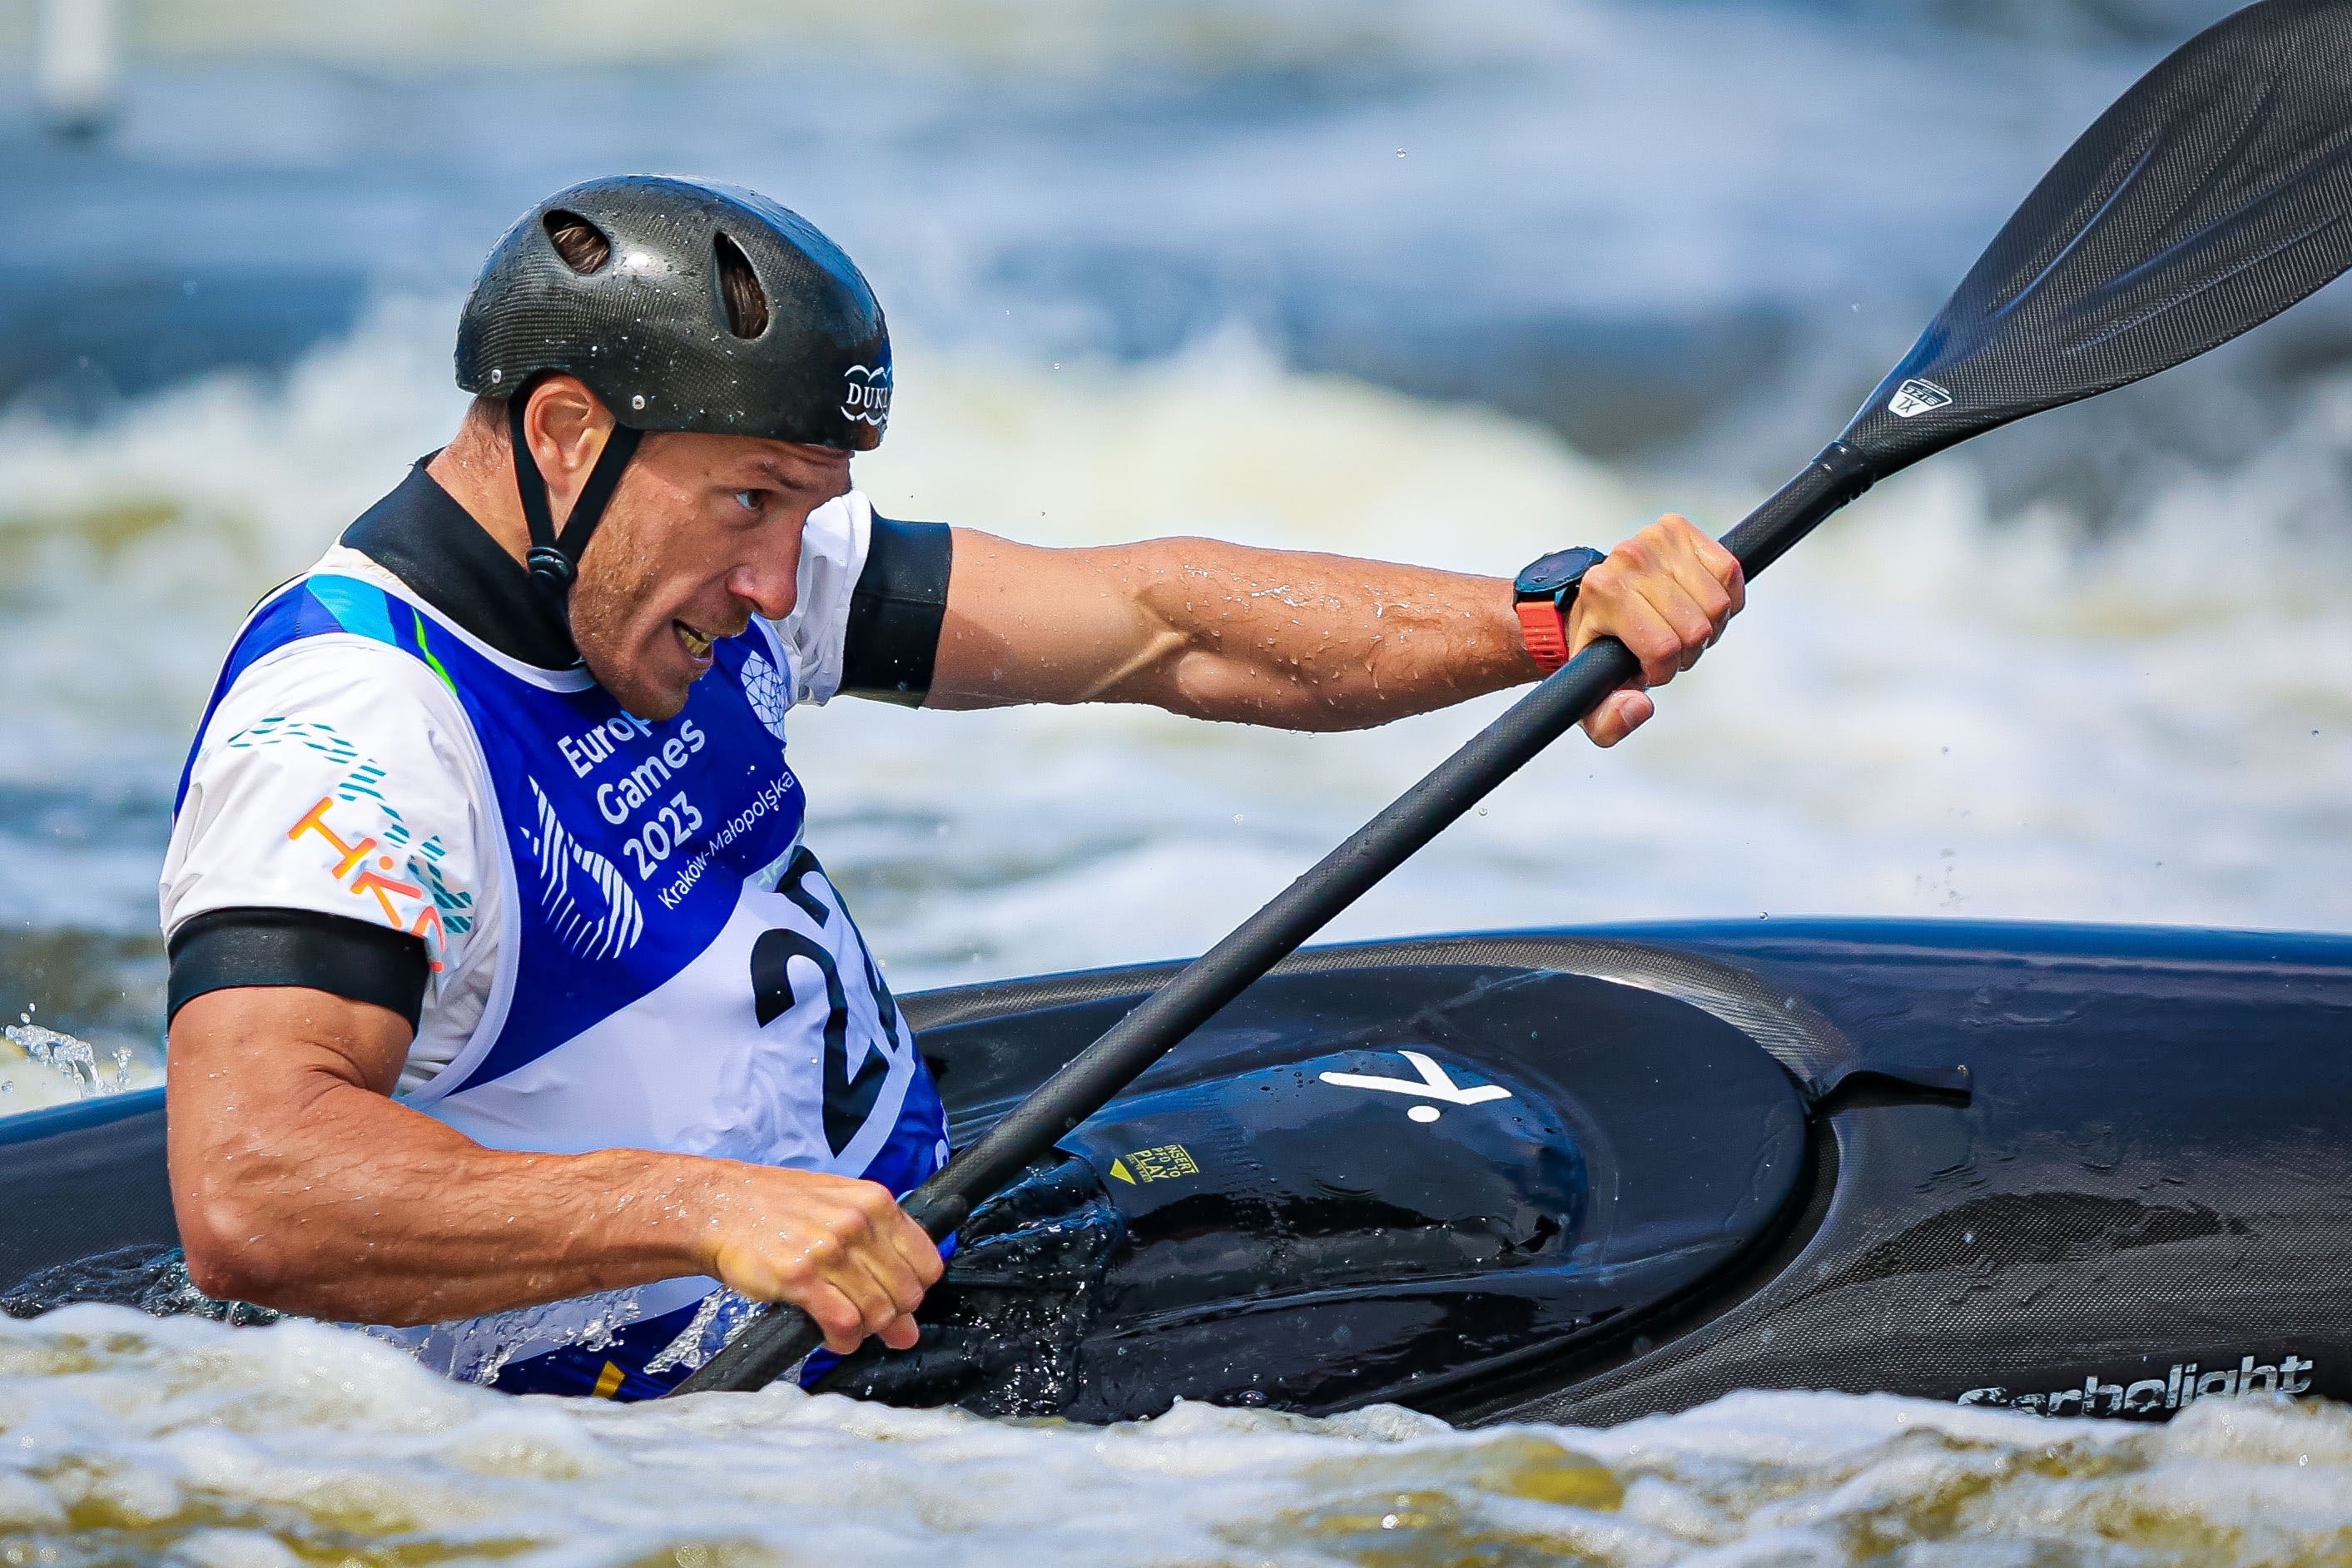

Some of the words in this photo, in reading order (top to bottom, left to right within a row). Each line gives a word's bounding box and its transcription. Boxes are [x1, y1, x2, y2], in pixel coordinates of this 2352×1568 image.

[1896, 396, 1920, 414] XL
[1903, 385, 1939, 406] SIZE
[557, 709, 653, 778] Europ
[597, 719, 705, 825] Games
[623, 791, 702, 881] 2023
[657, 771, 795, 910] Kraków-Małopolska
[1133, 1149, 1170, 1179] PLAY
[1151, 1147, 1171, 1164] PFD
[1167, 1165, 1181, 1178] TO
[1164, 1144, 1197, 1174] INSERT
